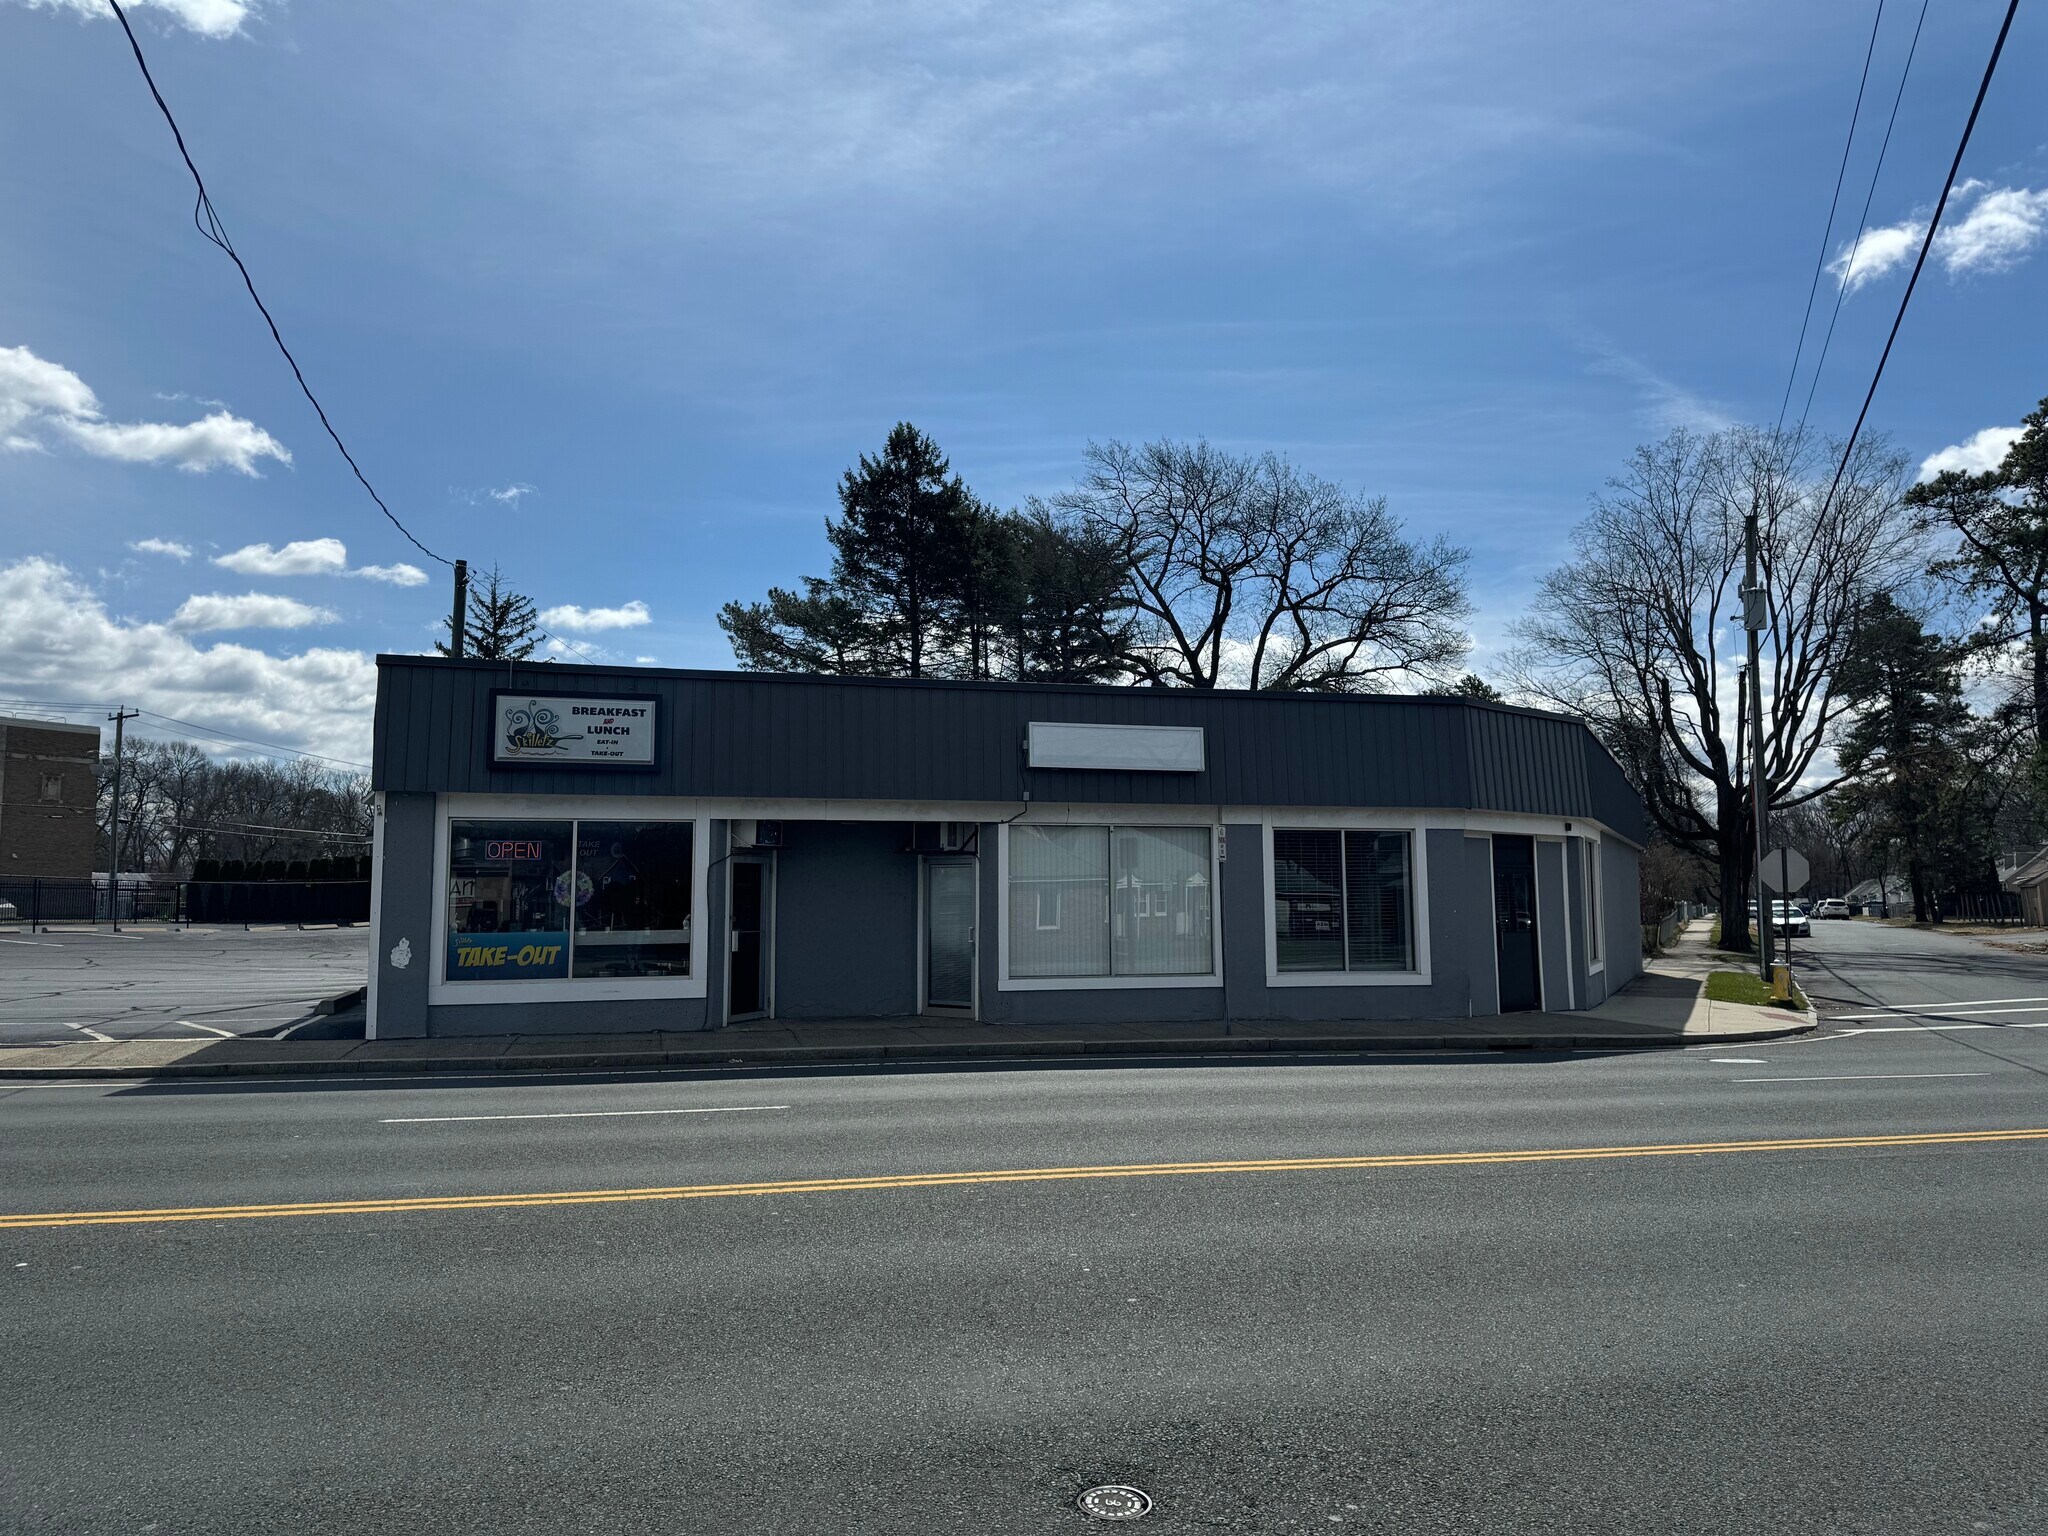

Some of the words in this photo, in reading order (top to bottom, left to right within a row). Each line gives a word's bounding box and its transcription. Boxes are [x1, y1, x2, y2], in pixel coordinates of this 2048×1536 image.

[571, 707, 646, 718] BREAKFAST
[587, 726, 630, 736] LUNCH
[578, 840, 601, 848] TAKE
[487, 841, 541, 859] OPEN
[579, 848, 599, 856] OUT
[457, 945, 562, 967] TAKE-OUT
